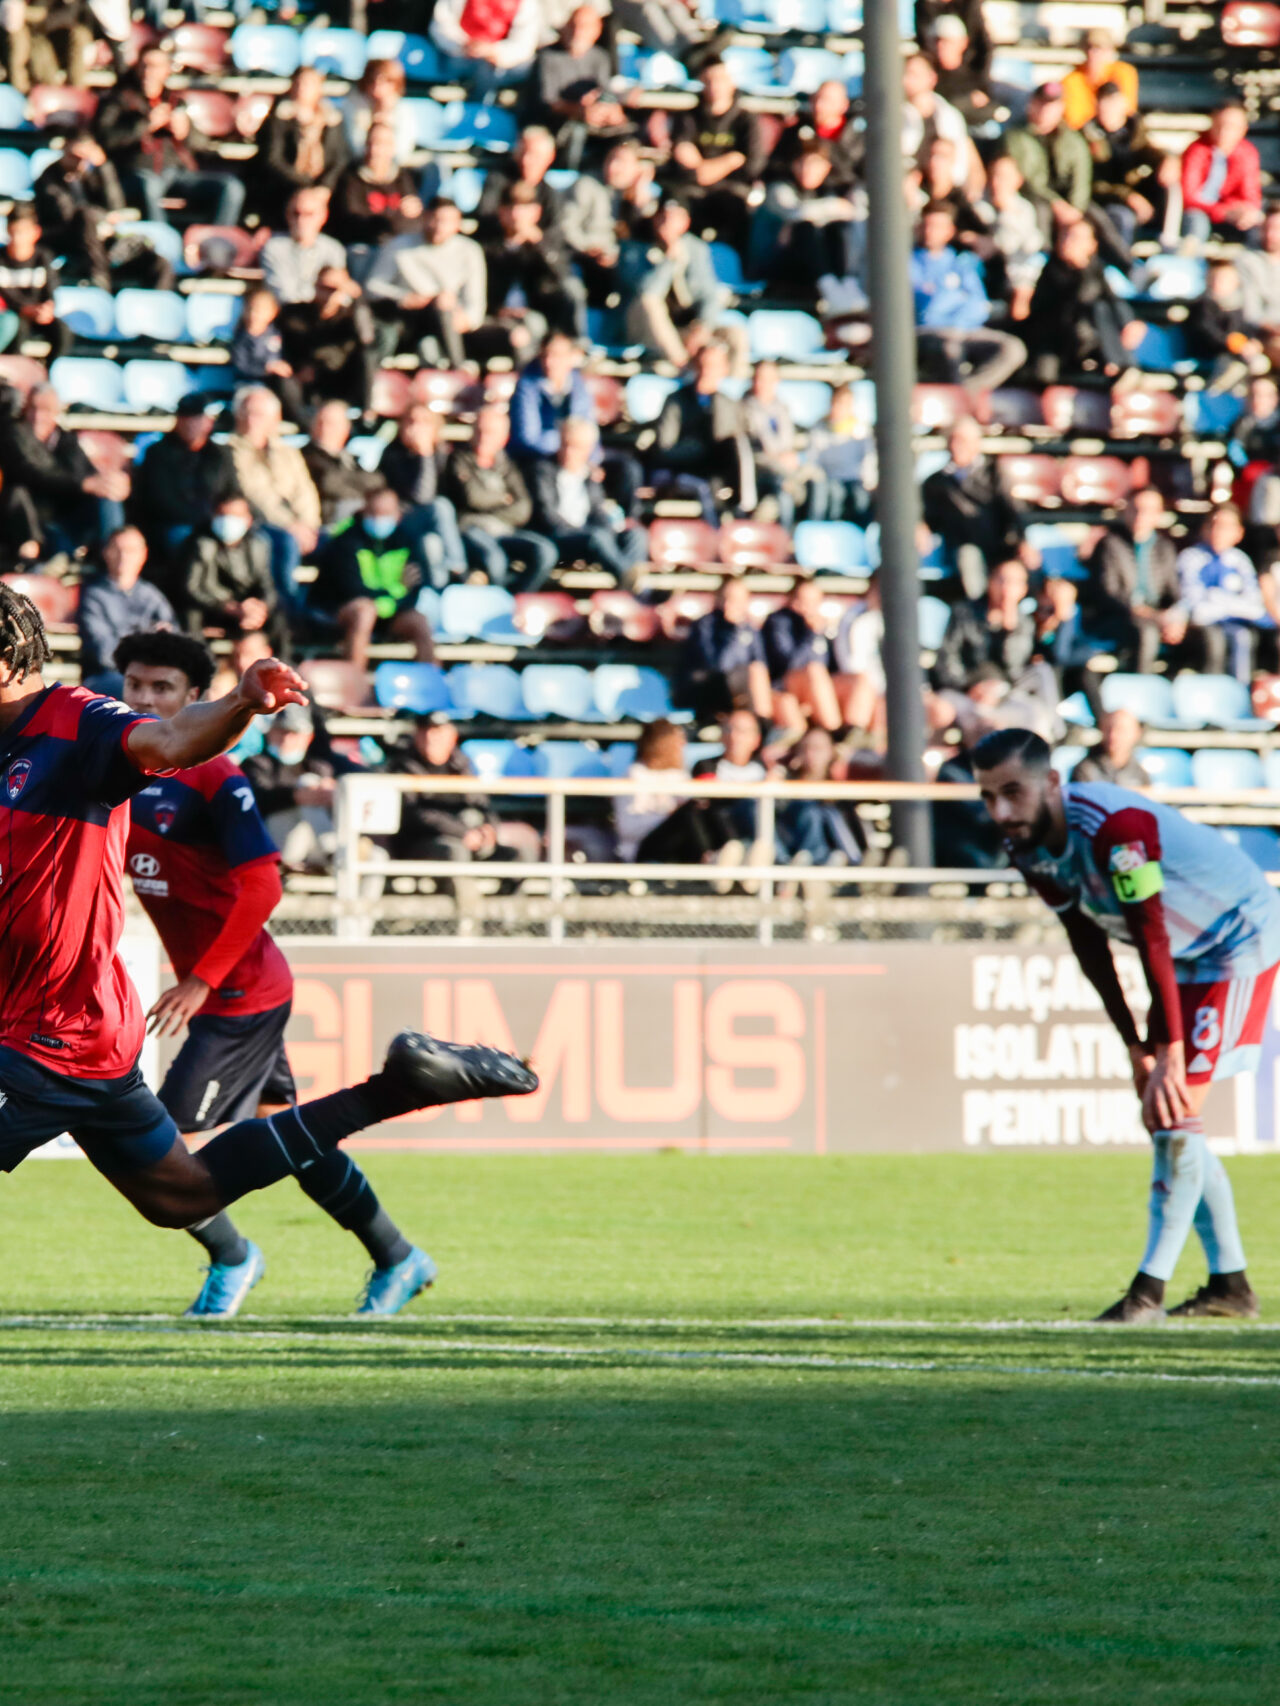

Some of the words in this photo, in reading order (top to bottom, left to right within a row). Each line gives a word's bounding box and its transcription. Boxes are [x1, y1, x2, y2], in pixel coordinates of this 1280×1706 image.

[1119, 874, 1136, 898] C
[954, 1023, 1133, 1080] ISOLATI
[1192, 1005, 1221, 1051] 8
[963, 1089, 1152, 1145] PEINTUR
